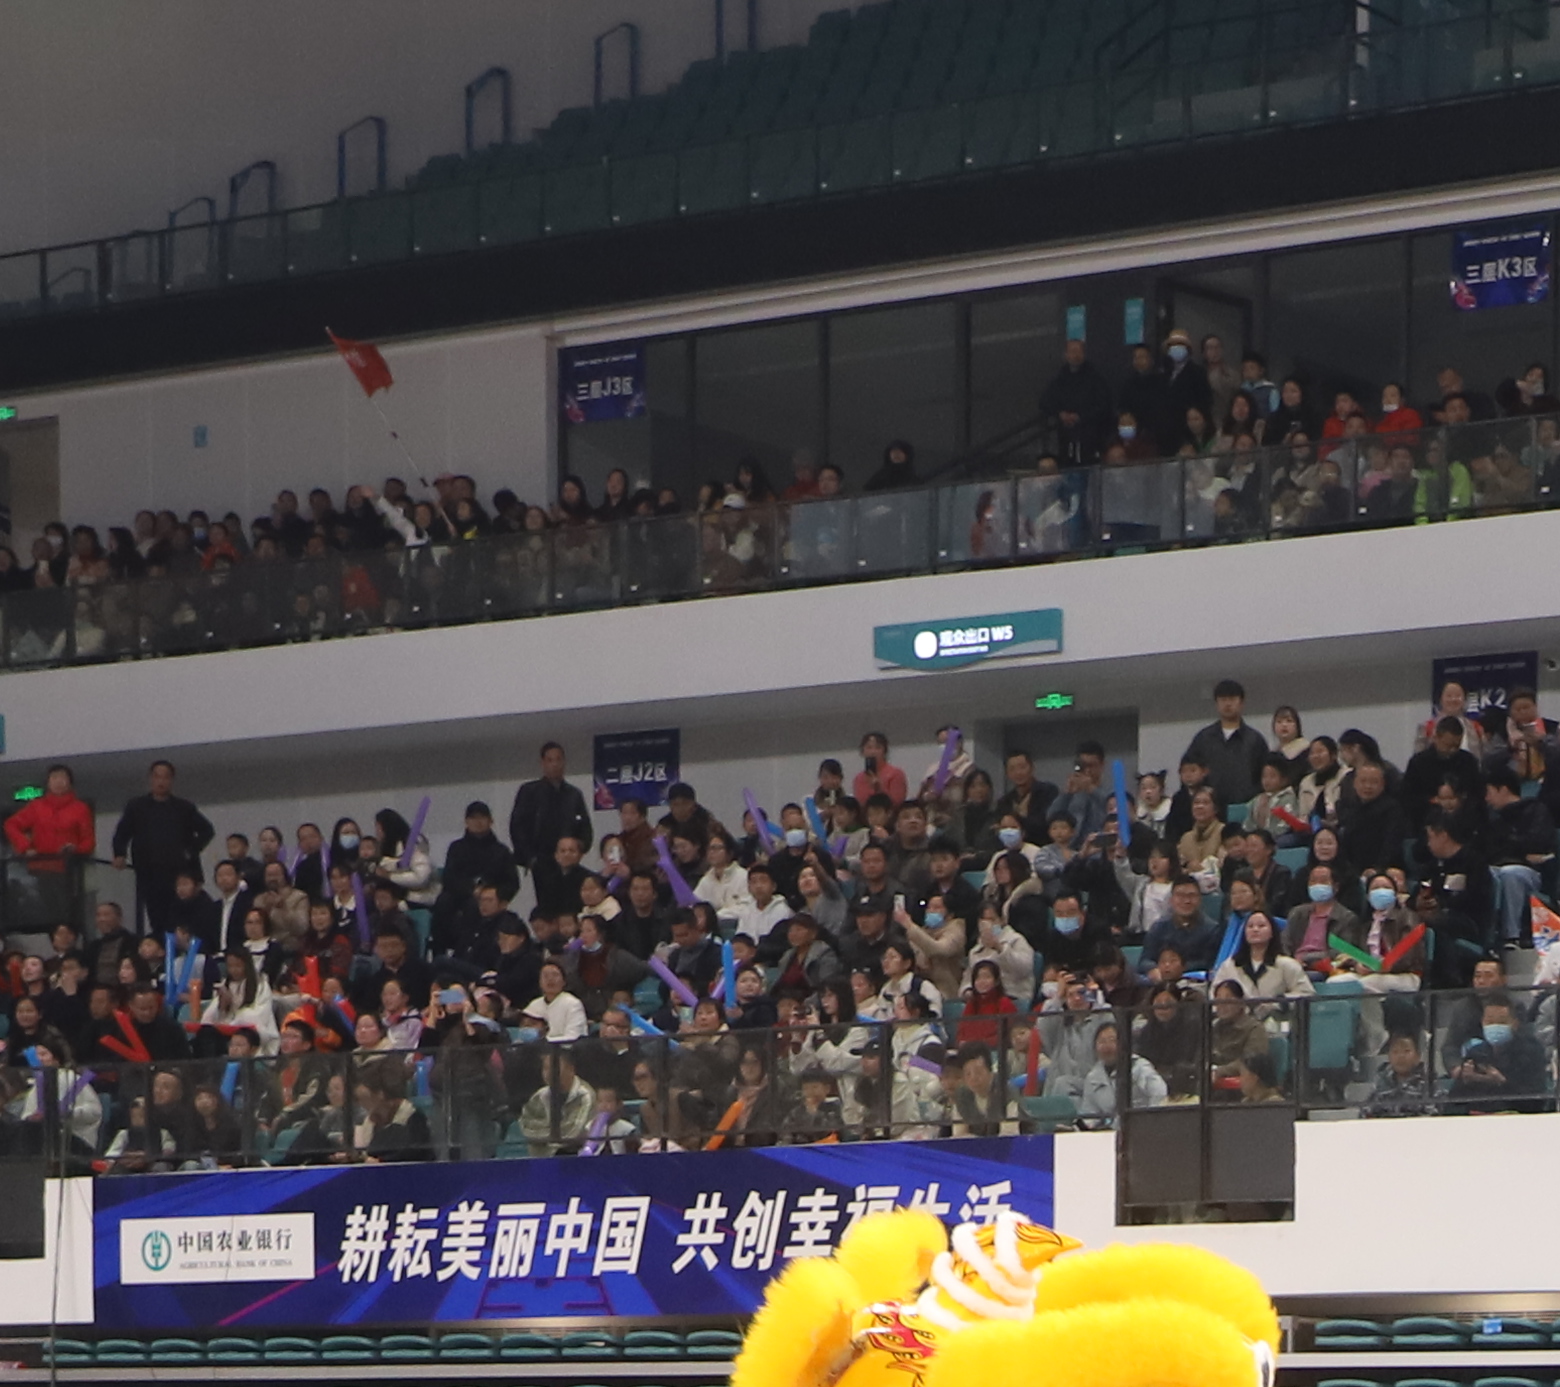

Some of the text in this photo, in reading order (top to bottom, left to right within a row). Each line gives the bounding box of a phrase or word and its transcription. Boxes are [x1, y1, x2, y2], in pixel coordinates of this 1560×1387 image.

[991, 625, 1014, 642] W5
[177, 1228, 293, 1254] 中国农业银行
[337, 1195, 651, 1283] 耕耘美丽中国
